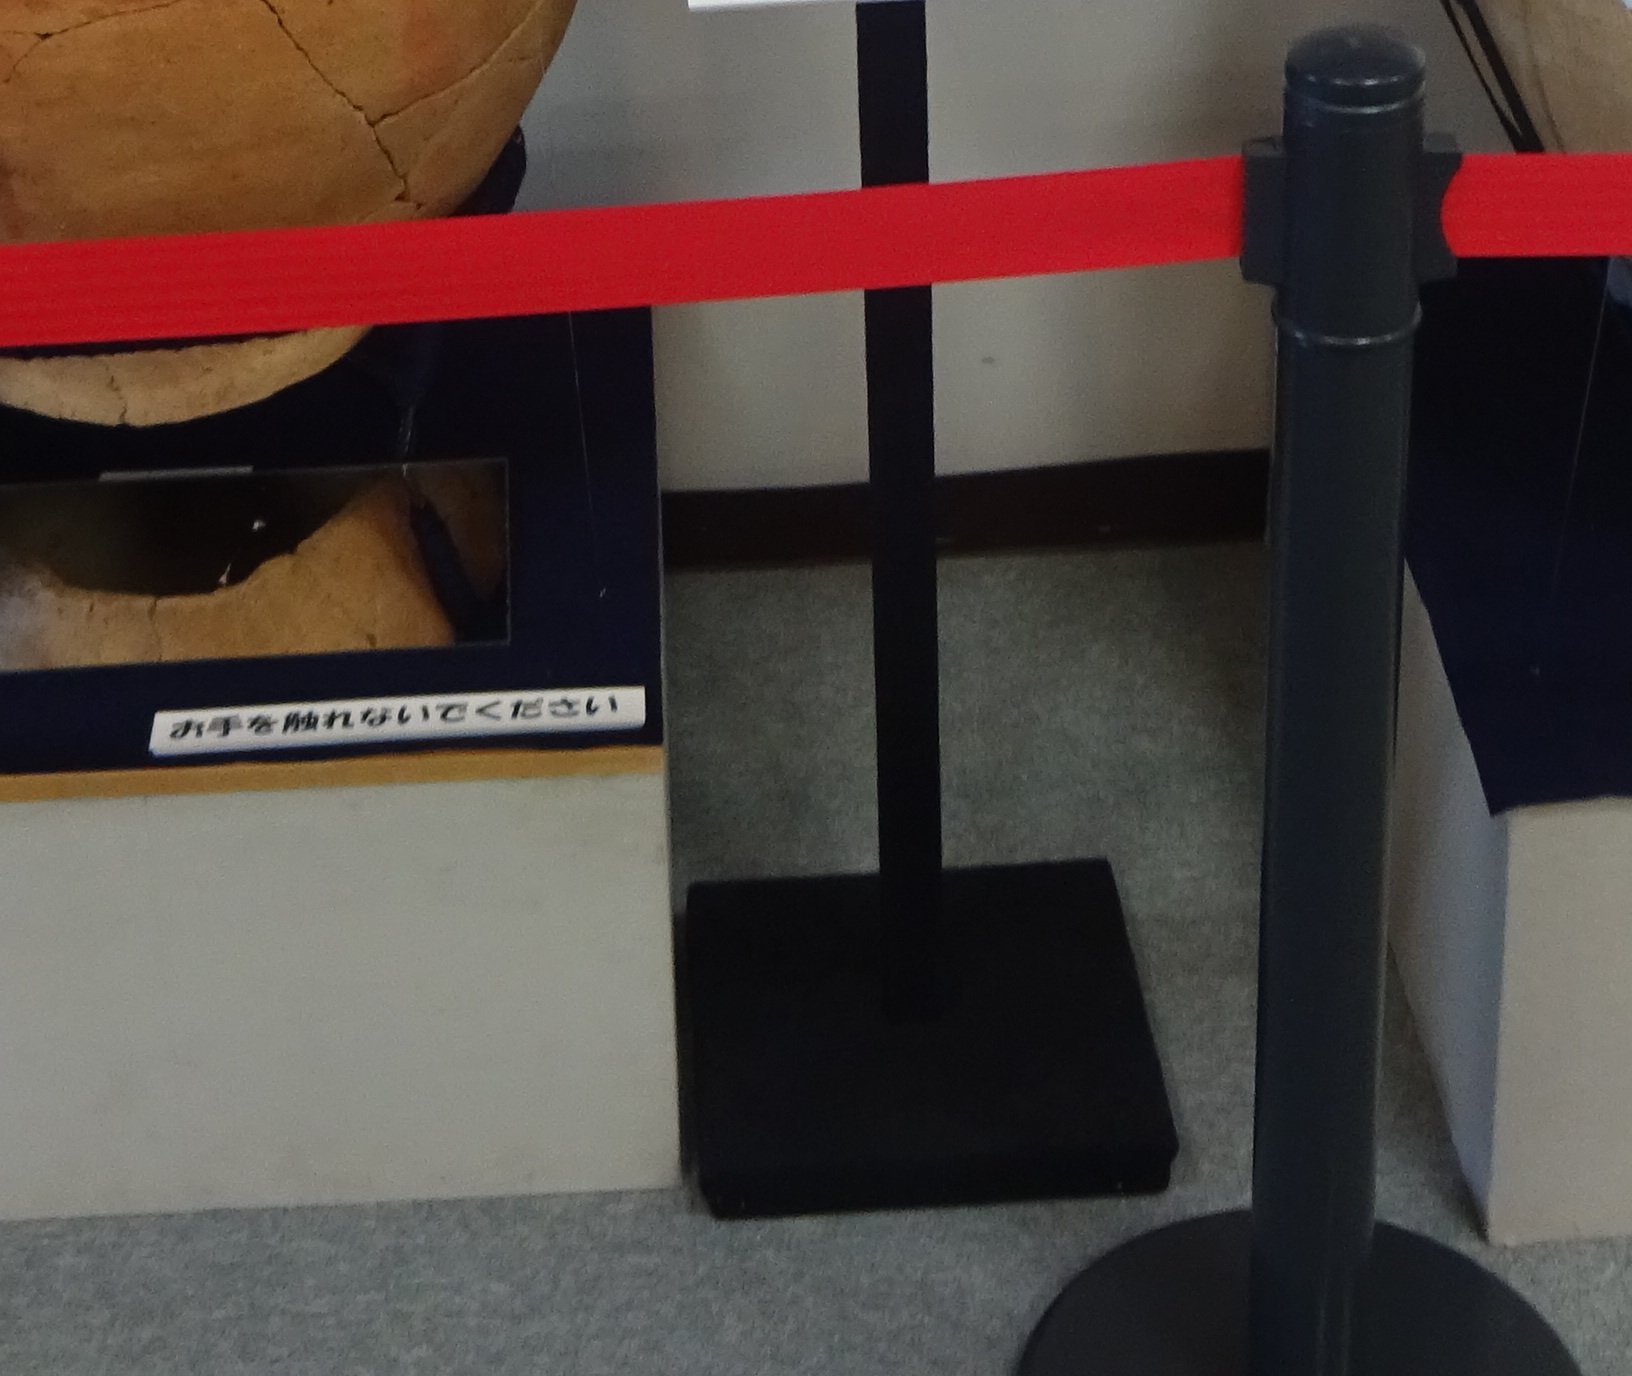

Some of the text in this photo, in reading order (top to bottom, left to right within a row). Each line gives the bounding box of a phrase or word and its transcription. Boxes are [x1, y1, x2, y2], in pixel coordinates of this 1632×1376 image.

[169, 695, 618, 740] お手を触れないでください
